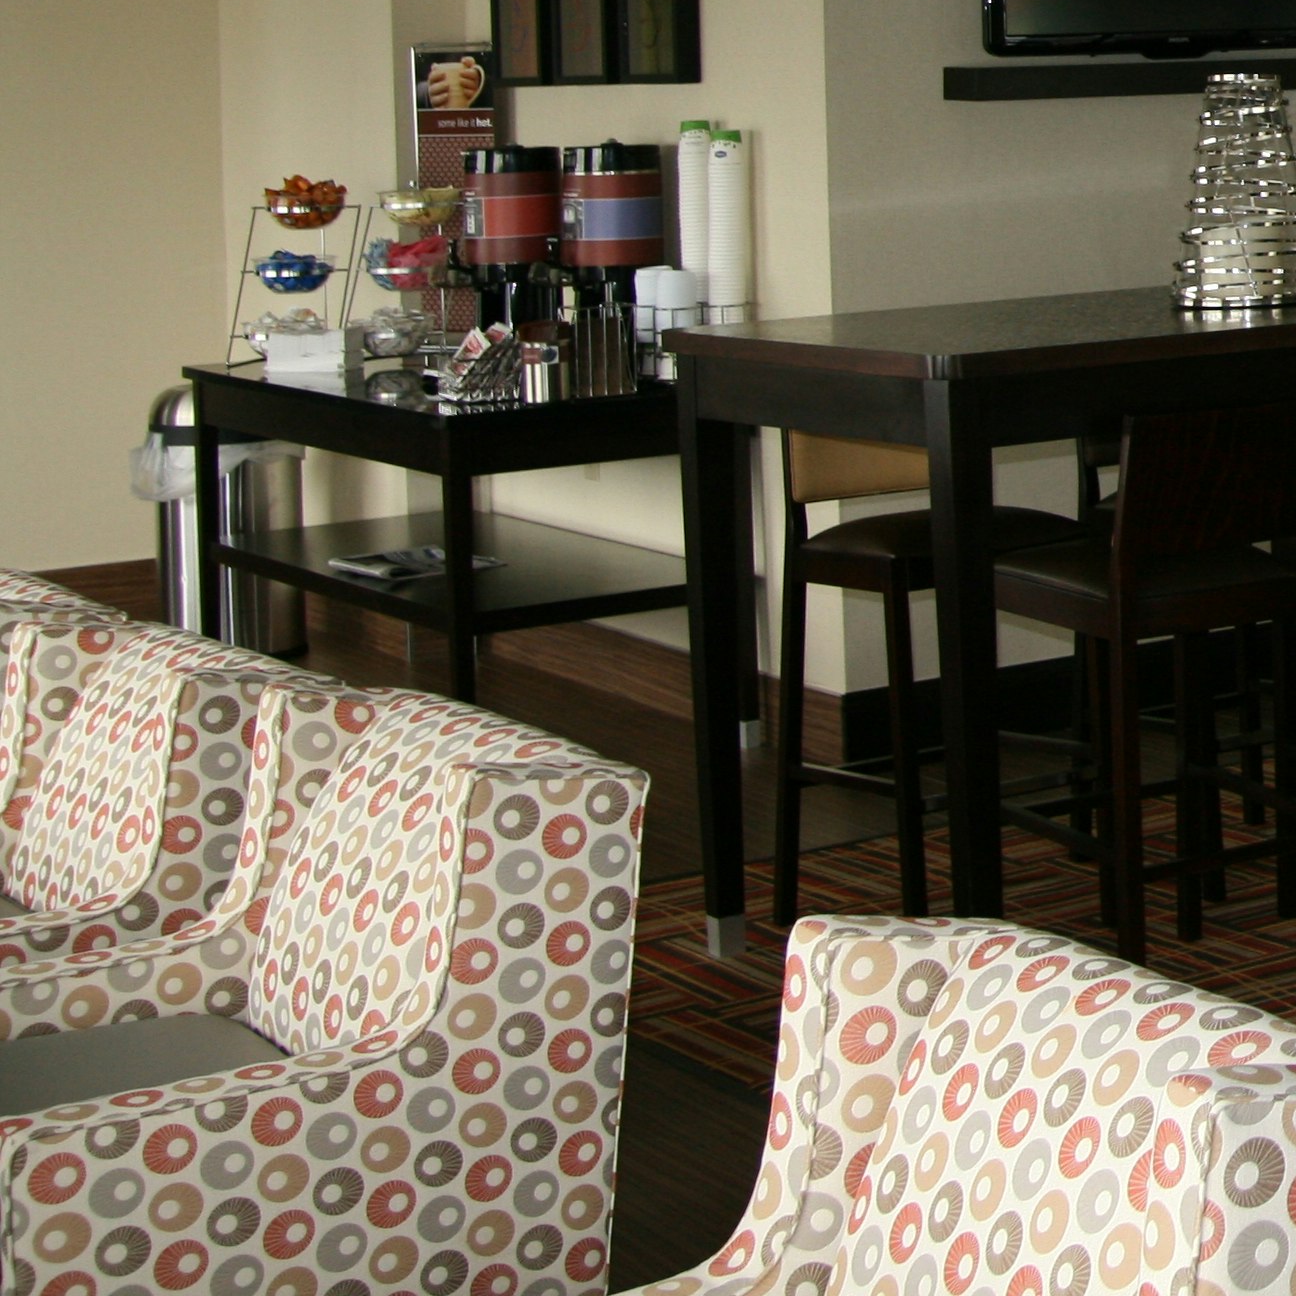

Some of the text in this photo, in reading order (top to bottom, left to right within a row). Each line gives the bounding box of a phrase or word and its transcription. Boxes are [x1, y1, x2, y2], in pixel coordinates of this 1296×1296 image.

[437, 119, 456, 129] some
[457, 117, 470, 128] like
[476, 116, 494, 128] hot.
